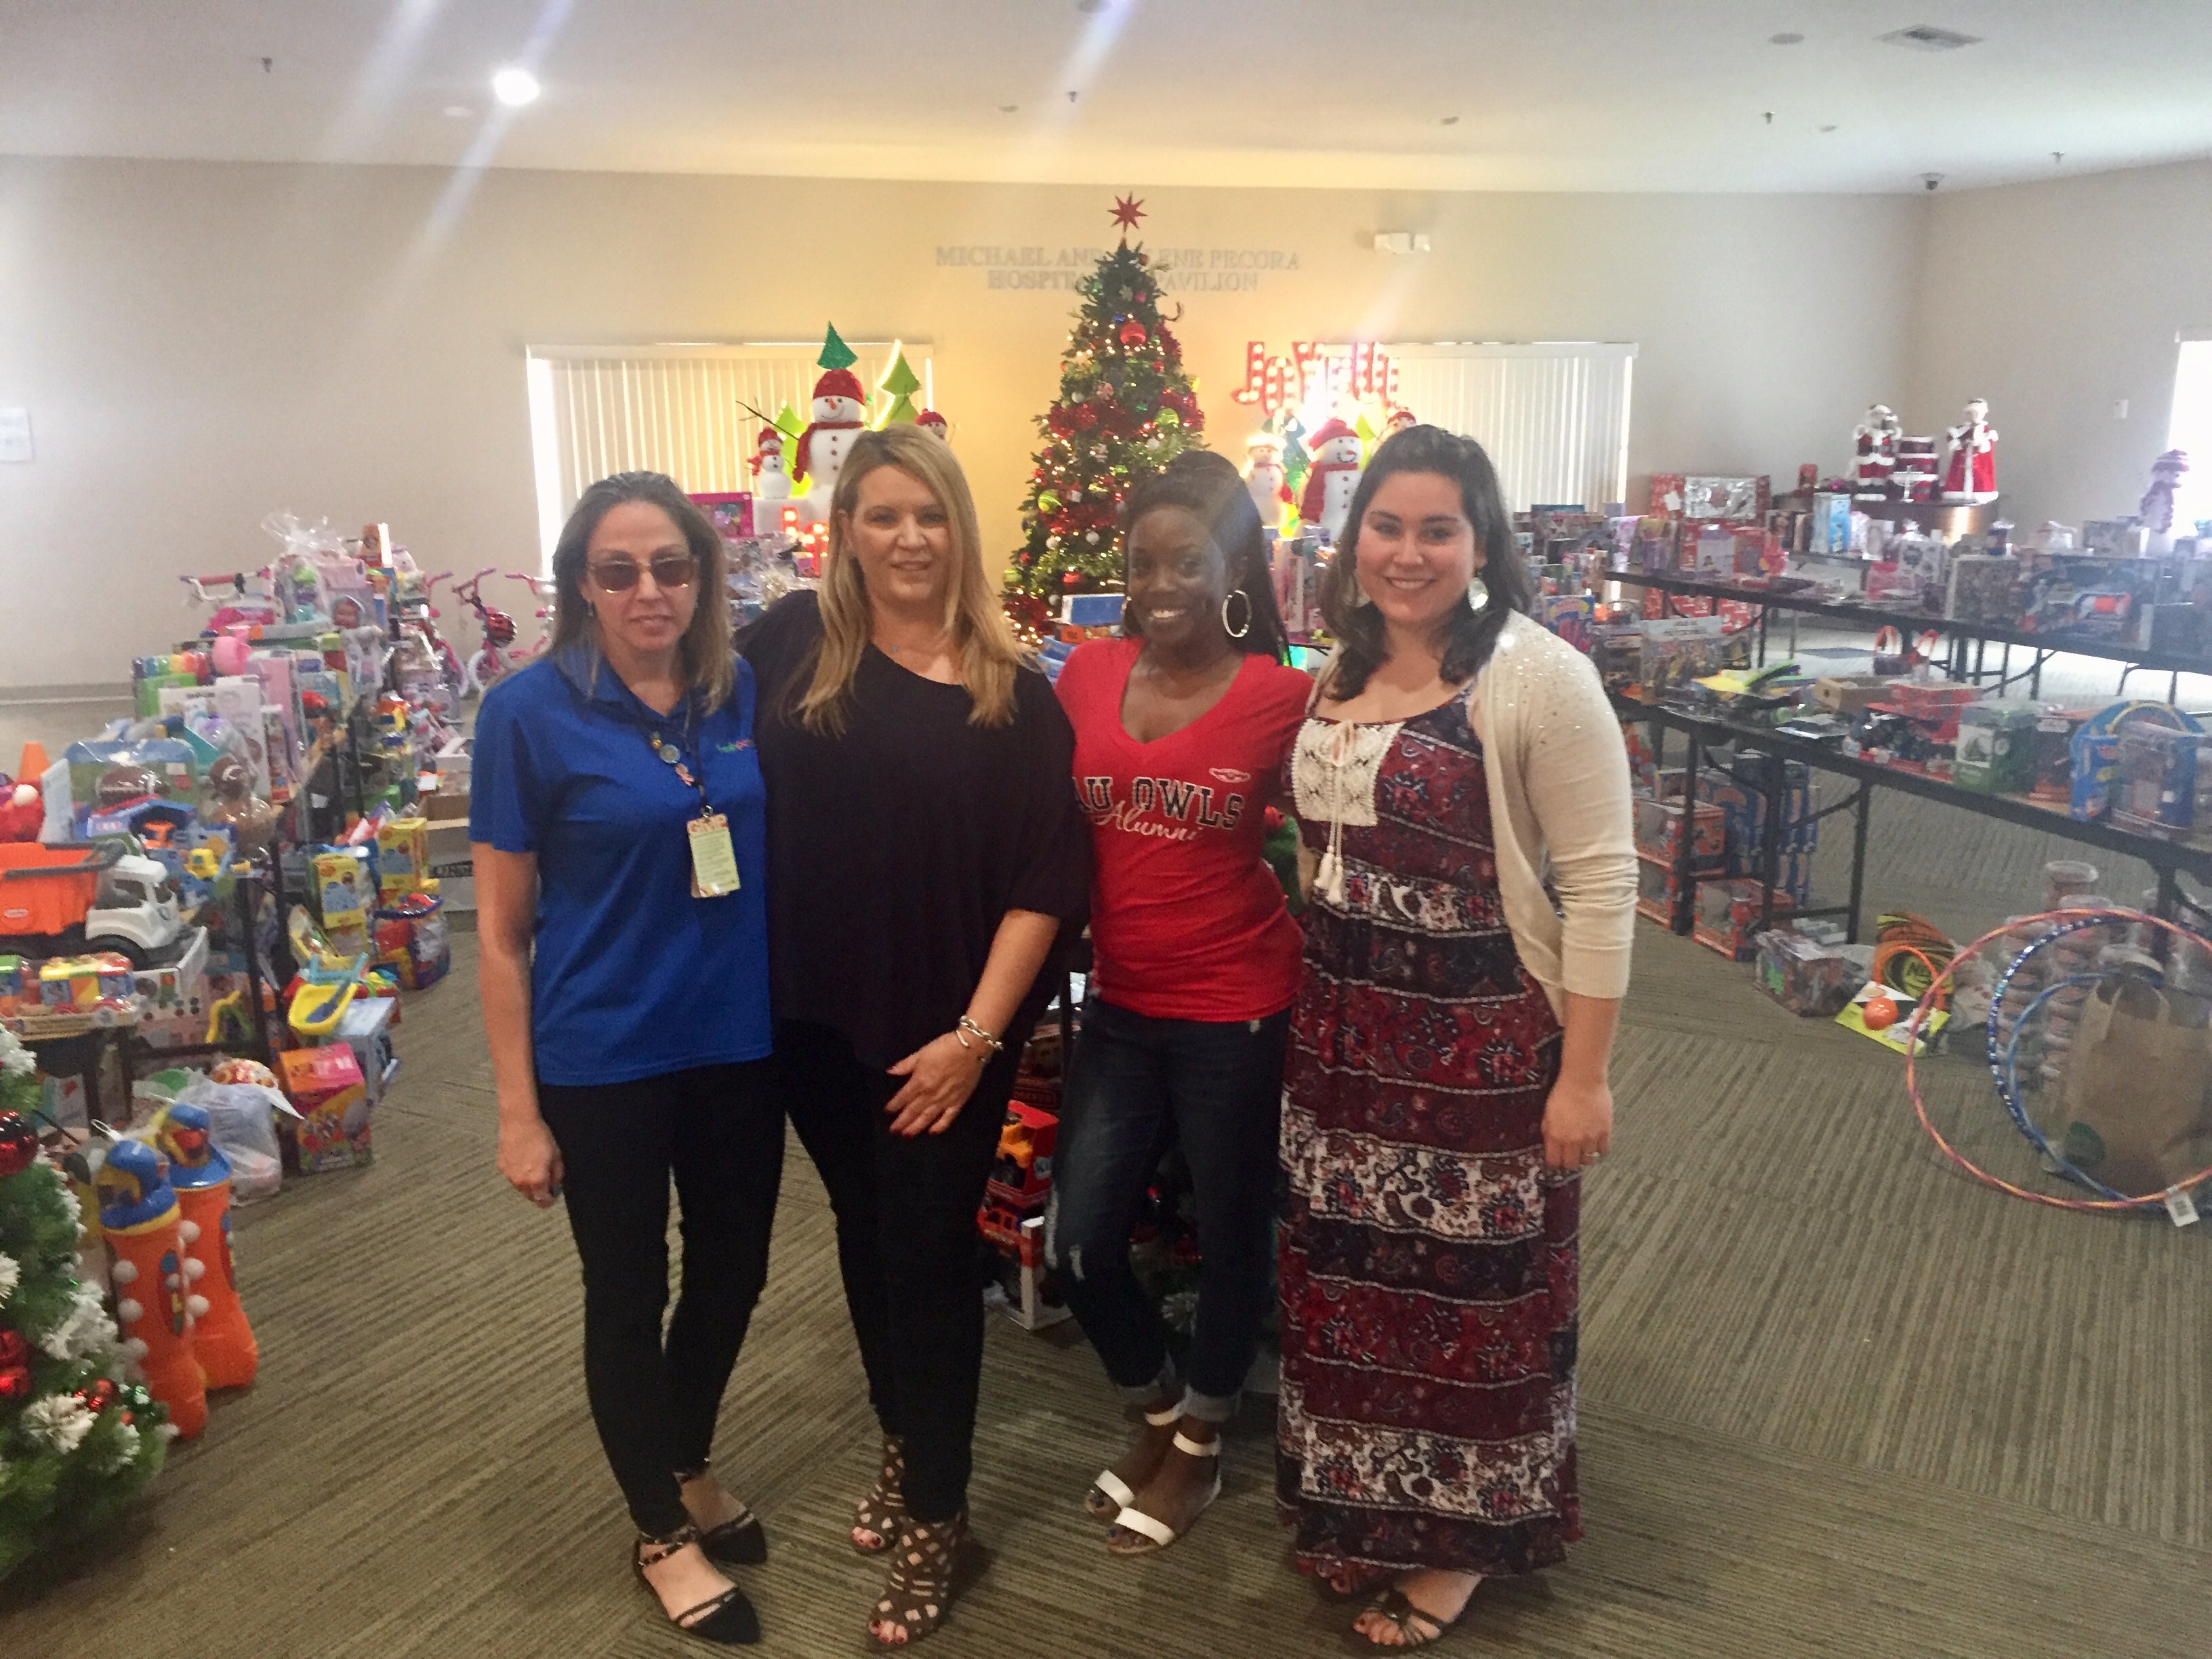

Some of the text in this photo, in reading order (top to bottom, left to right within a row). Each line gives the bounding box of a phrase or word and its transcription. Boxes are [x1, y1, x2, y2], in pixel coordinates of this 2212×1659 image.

[935, 245, 1050, 266] MICHAEL
[1209, 249, 1300, 270] PECORA
[1090, 800, 1204, 841] Alumni
[1132, 777, 1245, 830] OWLS
